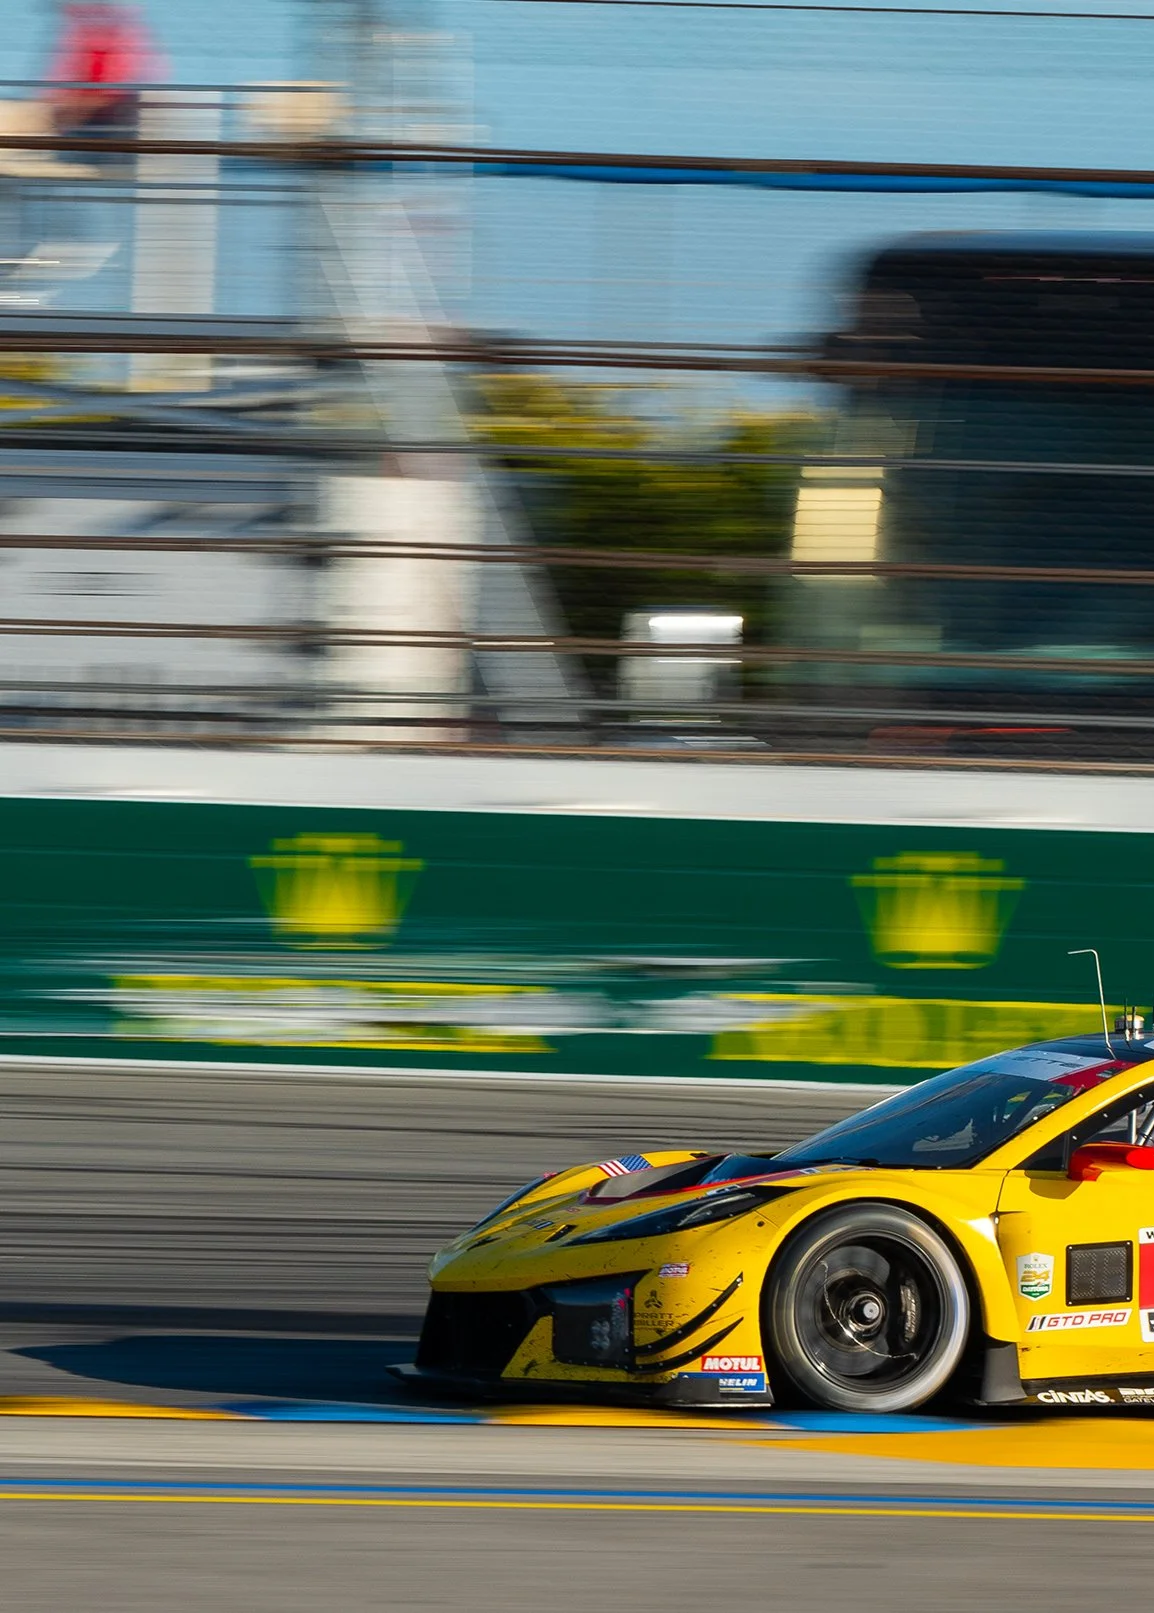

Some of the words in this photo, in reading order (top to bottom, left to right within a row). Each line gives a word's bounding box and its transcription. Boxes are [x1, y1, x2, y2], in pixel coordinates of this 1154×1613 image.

[1021, 1270, 1050, 1282] 24
[1047, 1315, 1084, 1327] GTD
[1088, 1312, 1127, 1324] PRO
